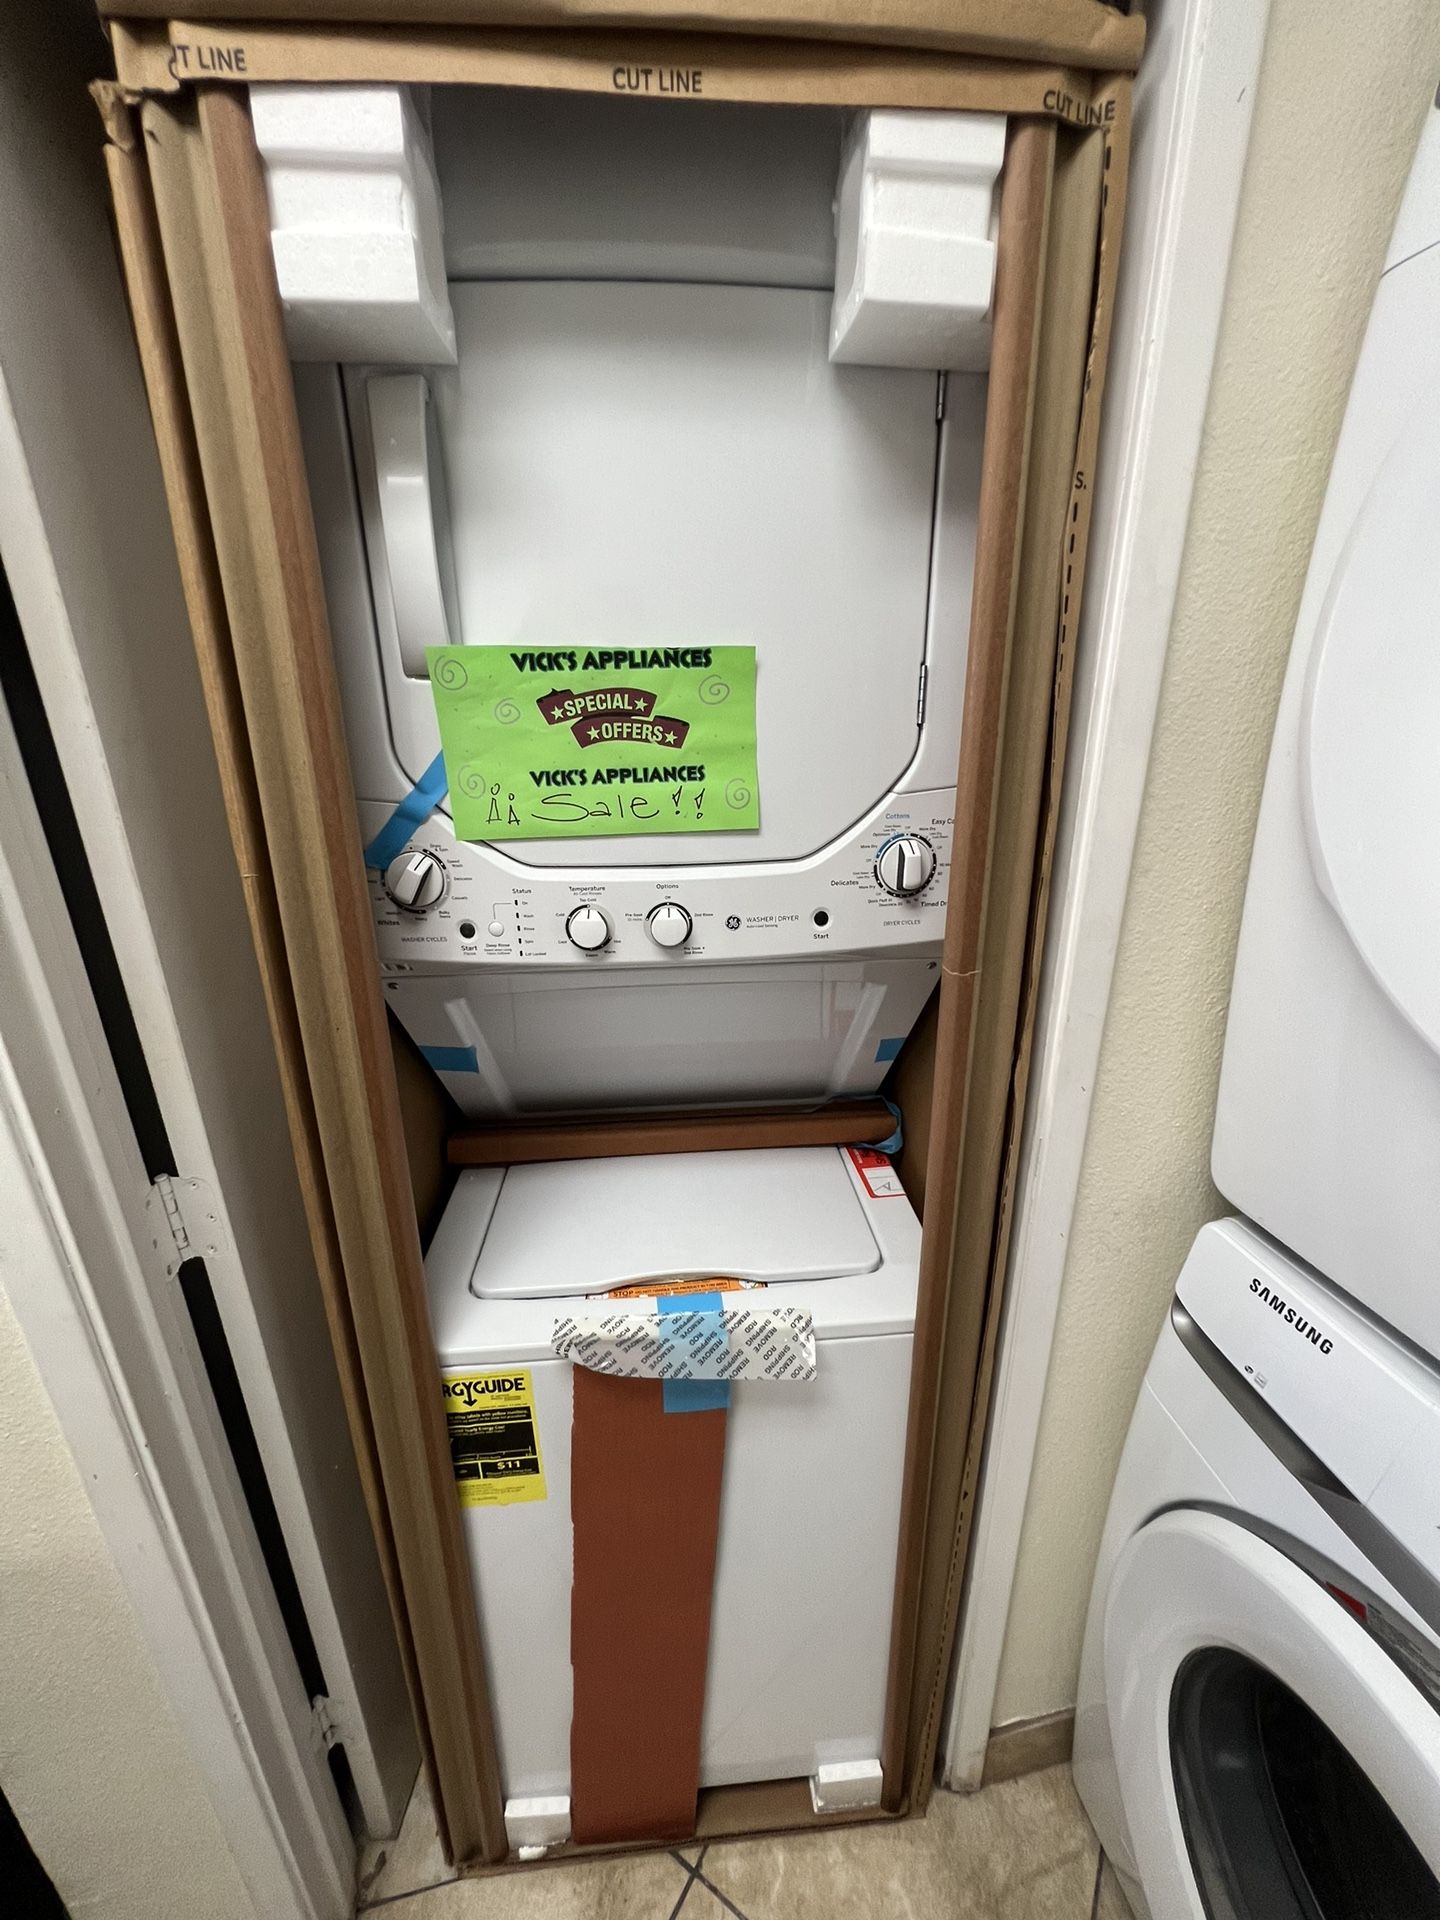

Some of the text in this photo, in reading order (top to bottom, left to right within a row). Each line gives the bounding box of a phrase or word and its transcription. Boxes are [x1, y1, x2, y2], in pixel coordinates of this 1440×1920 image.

[197, 46, 247, 72] LINE
[613, 67, 702, 93] CUT LINE
[1043, 89, 1116, 125] CUT LINE
[510, 648, 713, 672] VICK'S APPLIANCES
[563, 693, 633, 717] SPECIAL
[601, 721, 664, 742] OFFERS
[529, 764, 706, 787] VICK'S APPLIANCES
[613, 1290, 634, 1298] STOP
[744, 1320, 758, 1334] ROD
[1249, 1278, 1334, 1355] SAMSUNG
[689, 1332, 704, 1346] ROD
[690, 1331, 717, 1359] SHIPPING
[745, 1319, 772, 1347] SHIPPING
[753, 1326, 777, 1354] REMOVE
[641, 1340, 656, 1352] ROD
[649, 1344, 675, 1371] REMOVE
[698, 1338, 723, 1366] REMOVE
[715, 1348, 731, 1365] ROD
[762, 1345, 777, 1361] ROD
[658, 1361, 673, 1378] ROD
[764, 1344, 791, 1375] SHIPPING
[772, 1353, 797, 1380] REMOVE
[790, 1364, 804, 1379] ROD
[442, 1377, 526, 1402] RGYGUIDE
